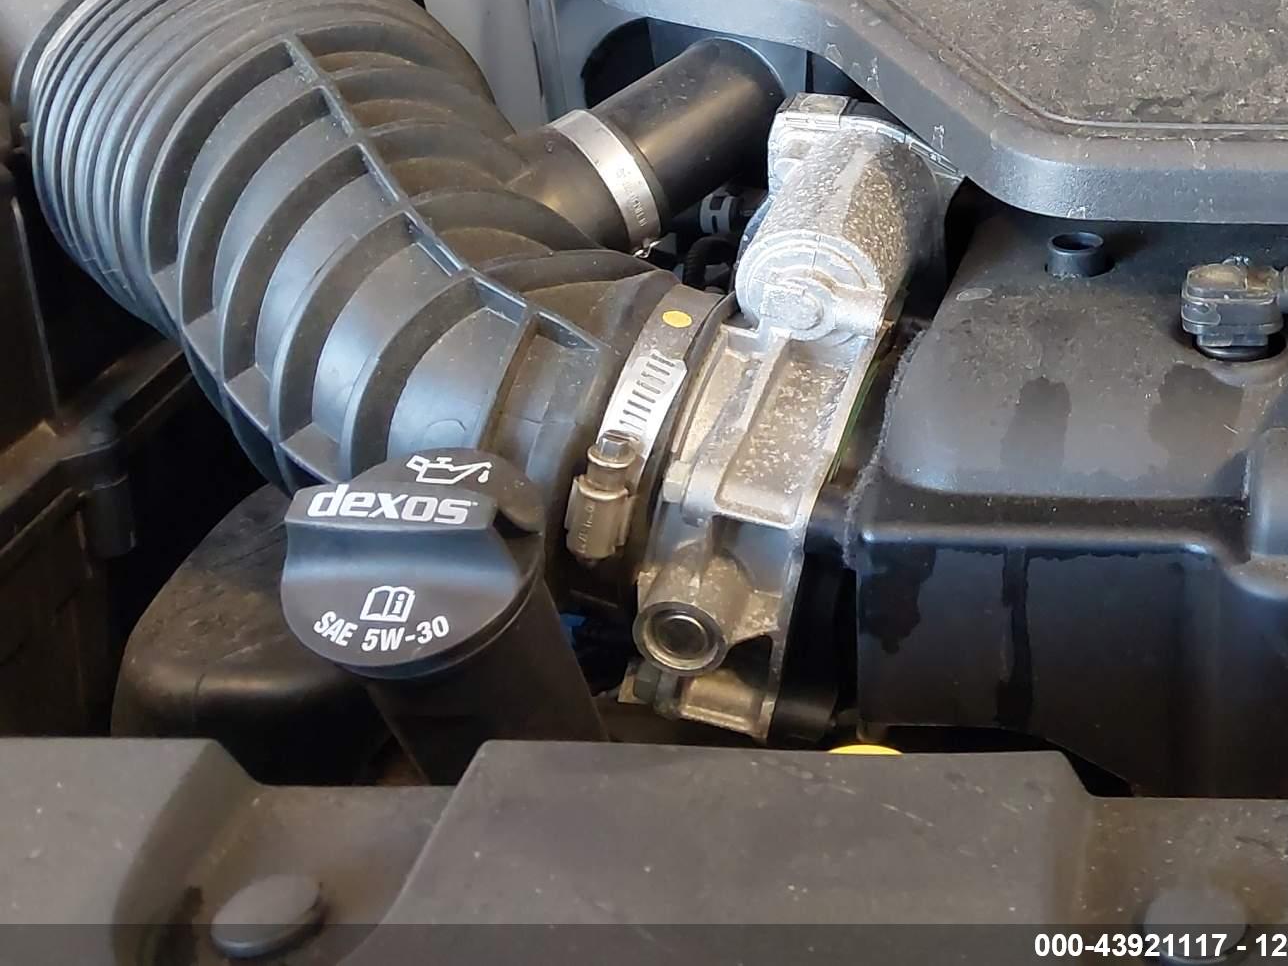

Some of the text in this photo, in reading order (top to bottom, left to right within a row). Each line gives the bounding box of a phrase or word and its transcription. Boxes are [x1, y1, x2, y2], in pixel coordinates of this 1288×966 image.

[307, 484, 472, 525] dexos
[313, 610, 450, 652] SAE 5W-30
